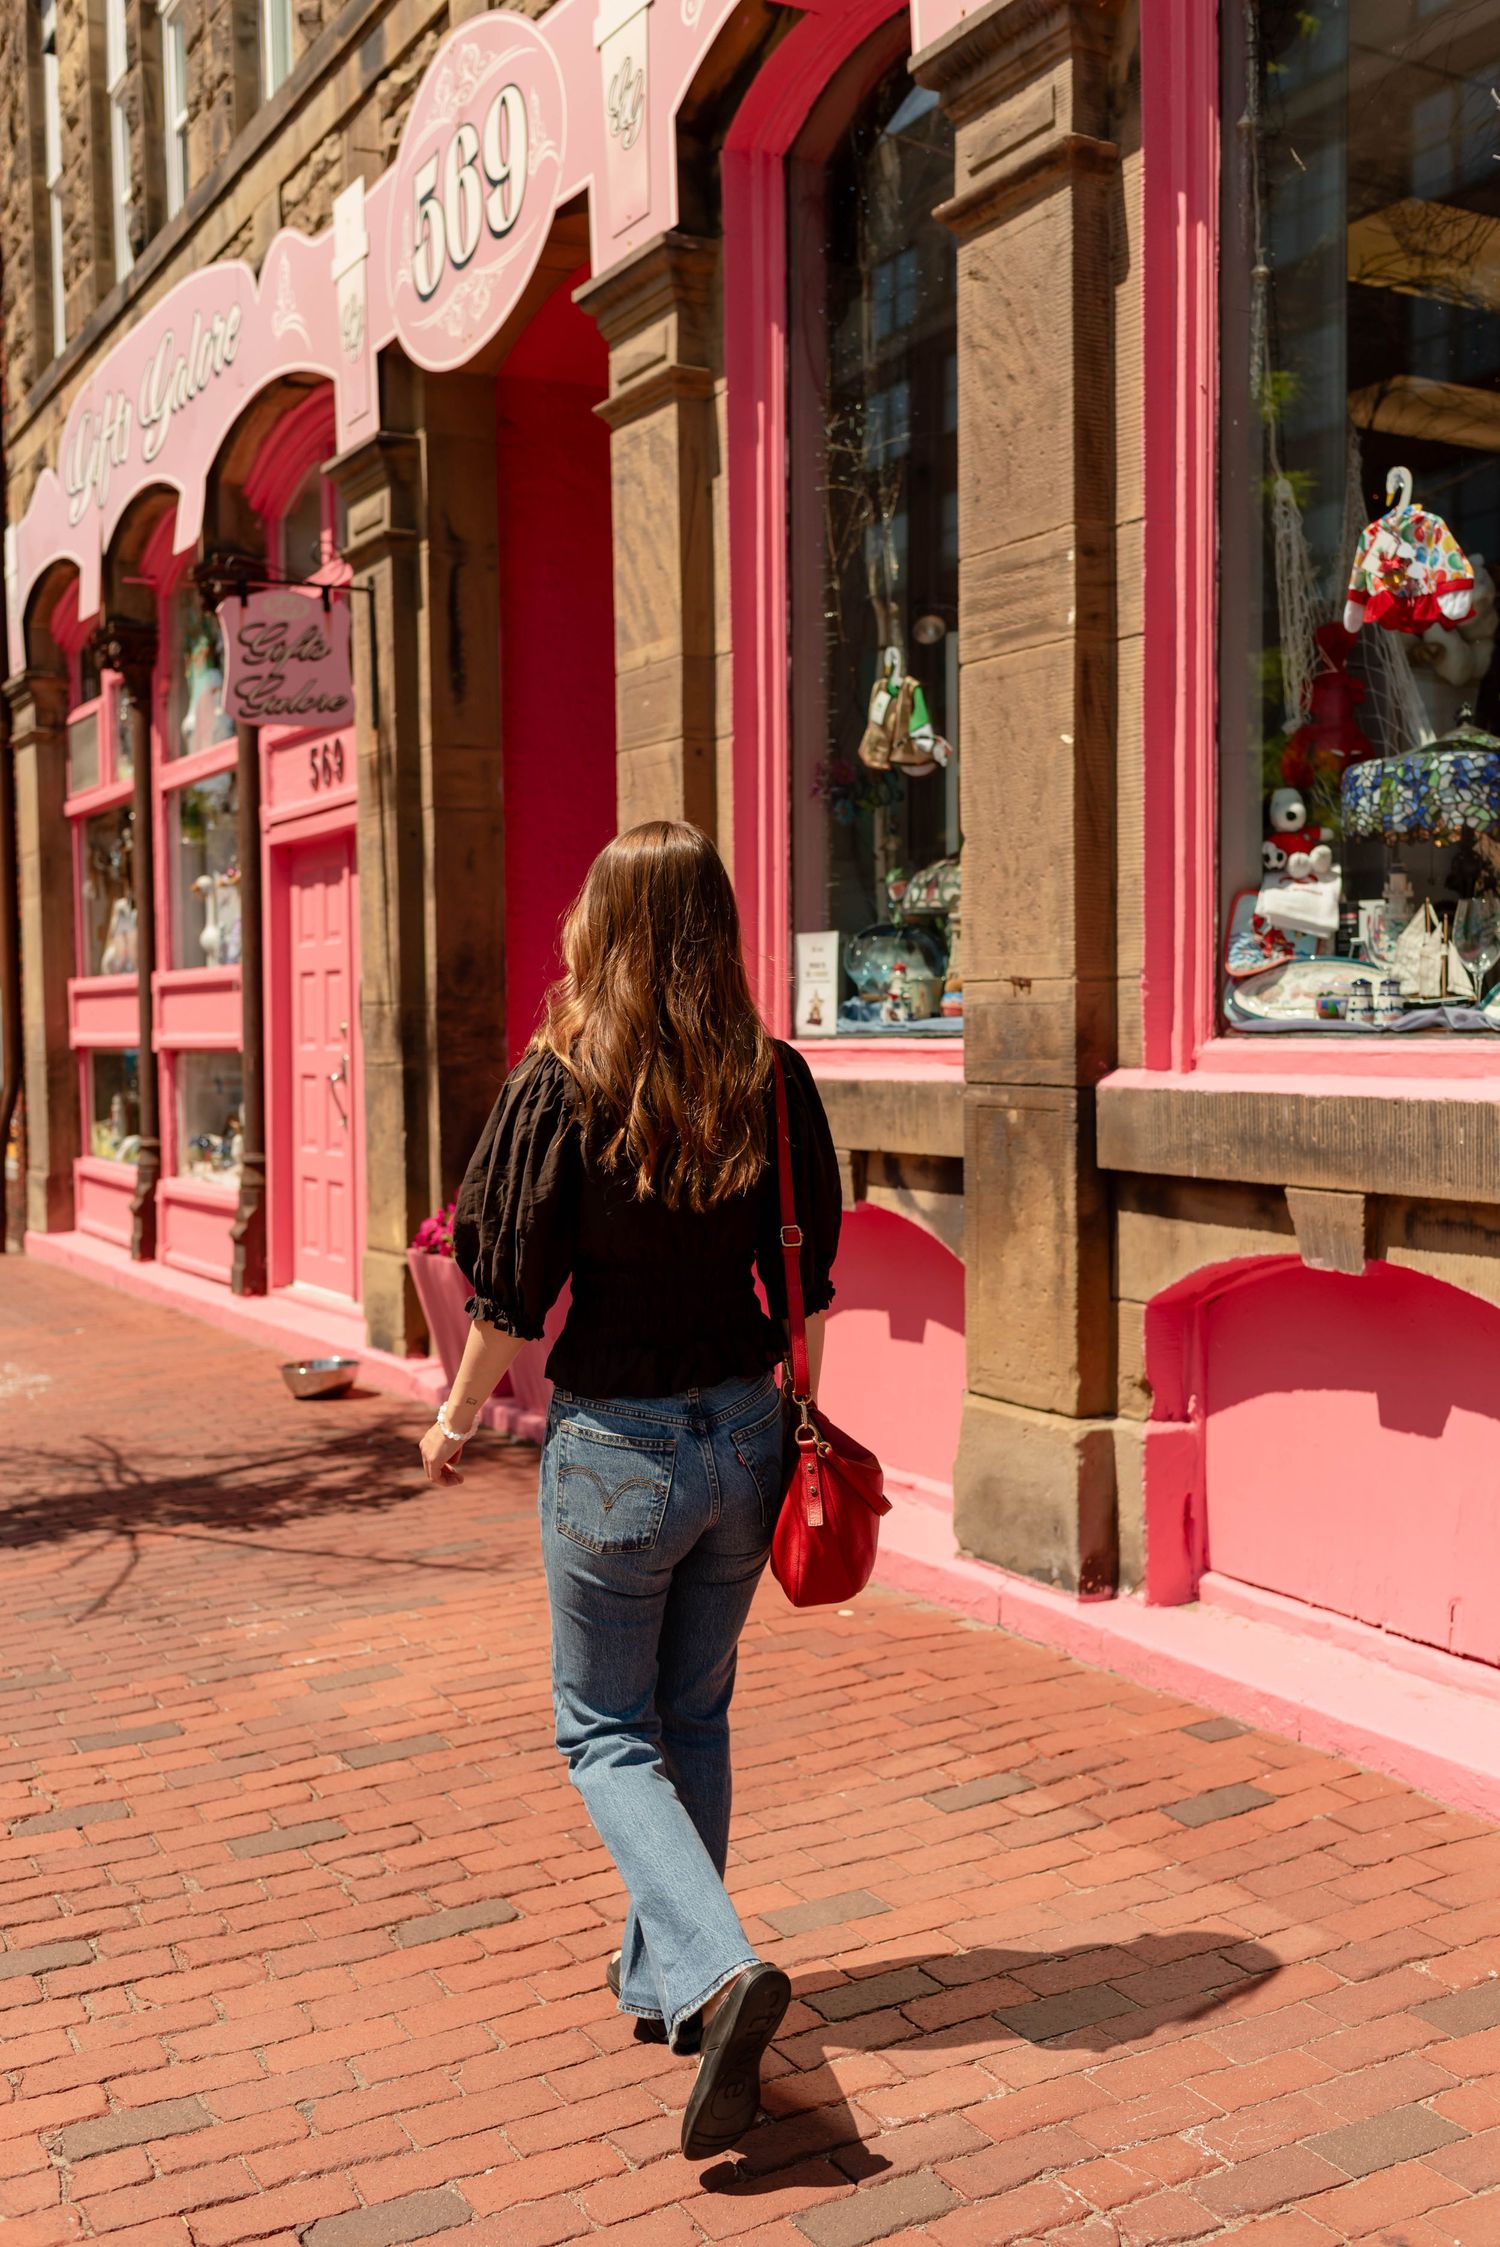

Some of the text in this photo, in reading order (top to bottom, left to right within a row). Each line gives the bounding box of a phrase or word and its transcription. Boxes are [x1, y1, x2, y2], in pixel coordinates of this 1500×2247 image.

[412, 83, 528, 302] 569
[66, 390, 132, 526] Gifts
[138, 303, 241, 463] Galore
[238, 621, 331, 674] Gifts
[234, 671, 348, 719] Galore
[310, 737, 344, 791] 569
